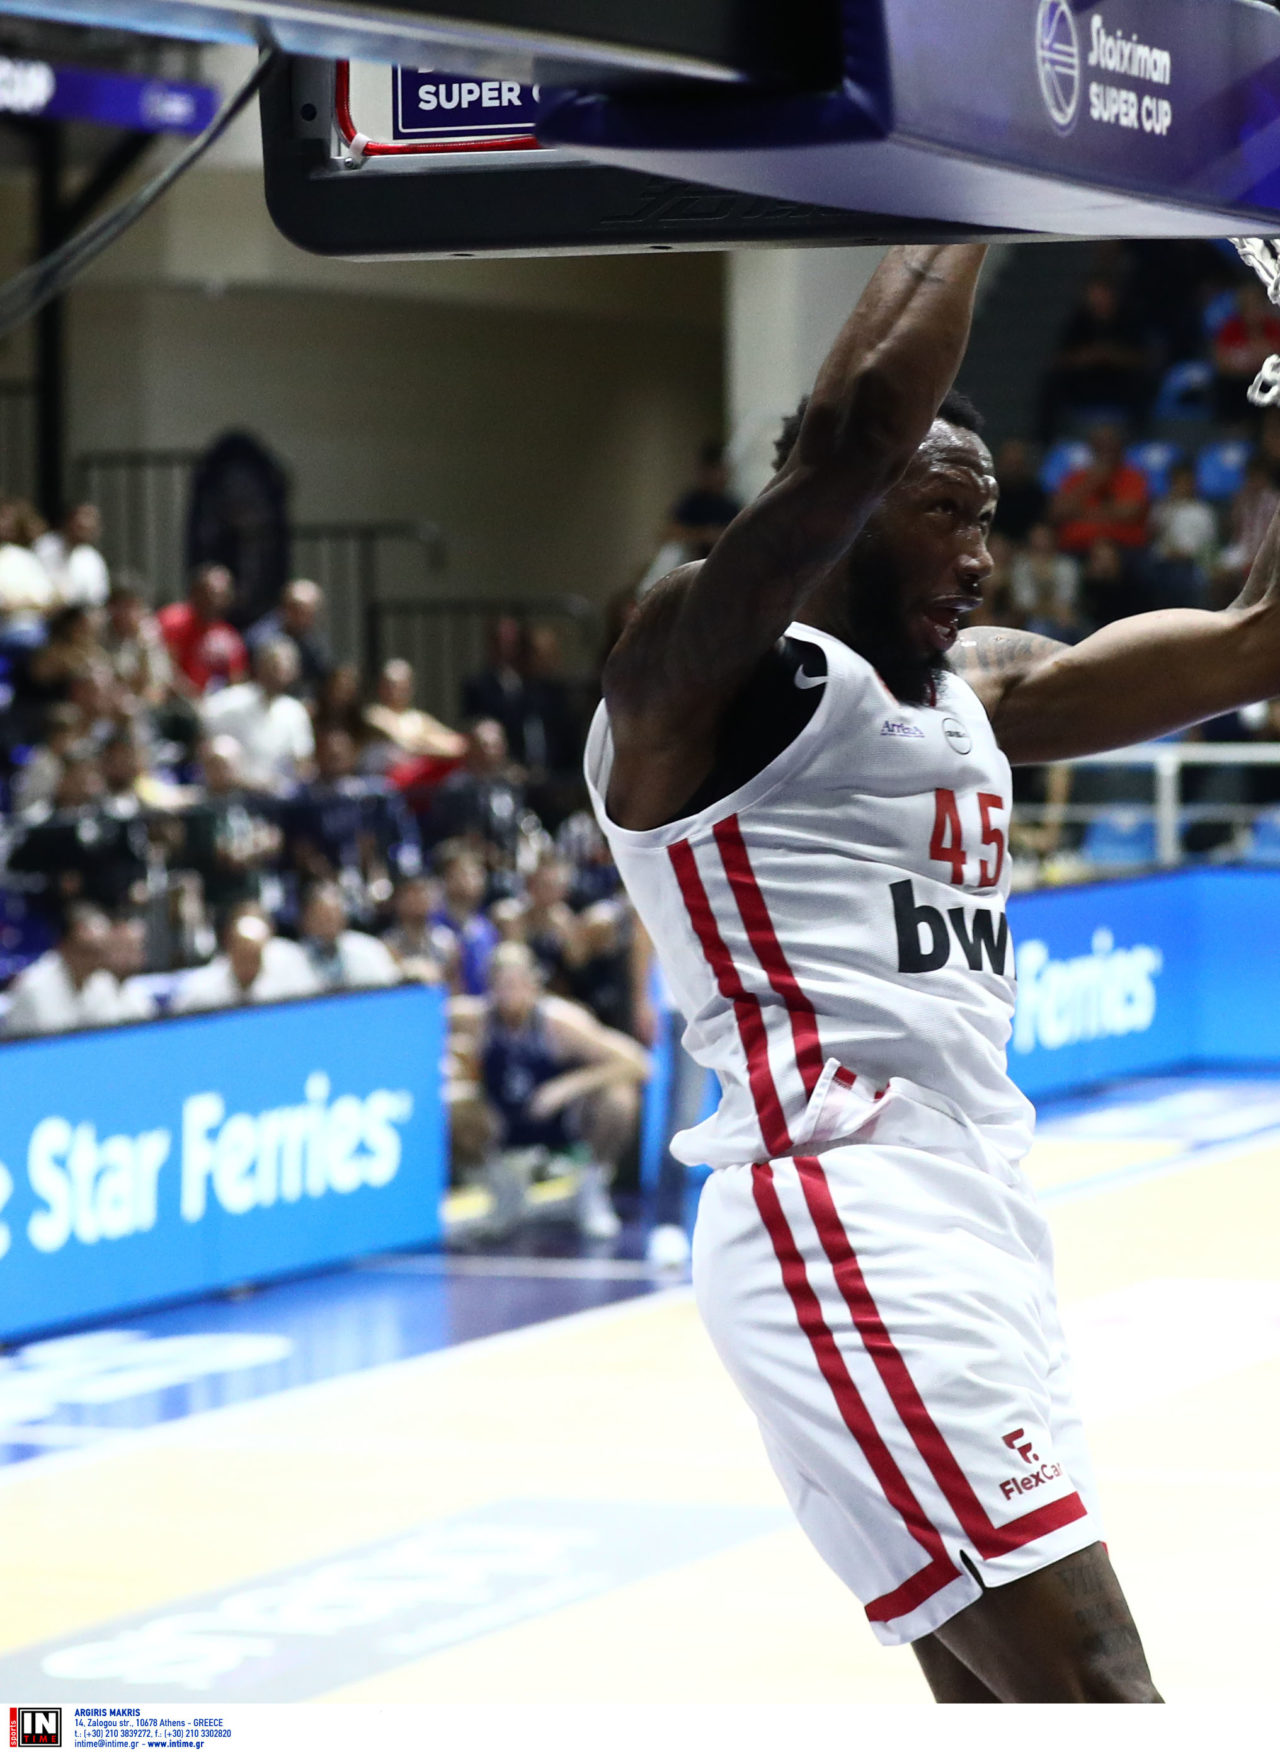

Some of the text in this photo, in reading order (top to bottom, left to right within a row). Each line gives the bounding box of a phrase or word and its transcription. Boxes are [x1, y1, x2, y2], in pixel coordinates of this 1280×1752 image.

[1088, 13, 1171, 85] Stoiximan
[418, 81, 522, 111] SUPER
[1089, 81, 1172, 136] SUPER CUP
[929, 788, 1005, 888] 45
[27, 1116, 171, 1252] Star
[181, 1070, 402, 1223] Ferries
